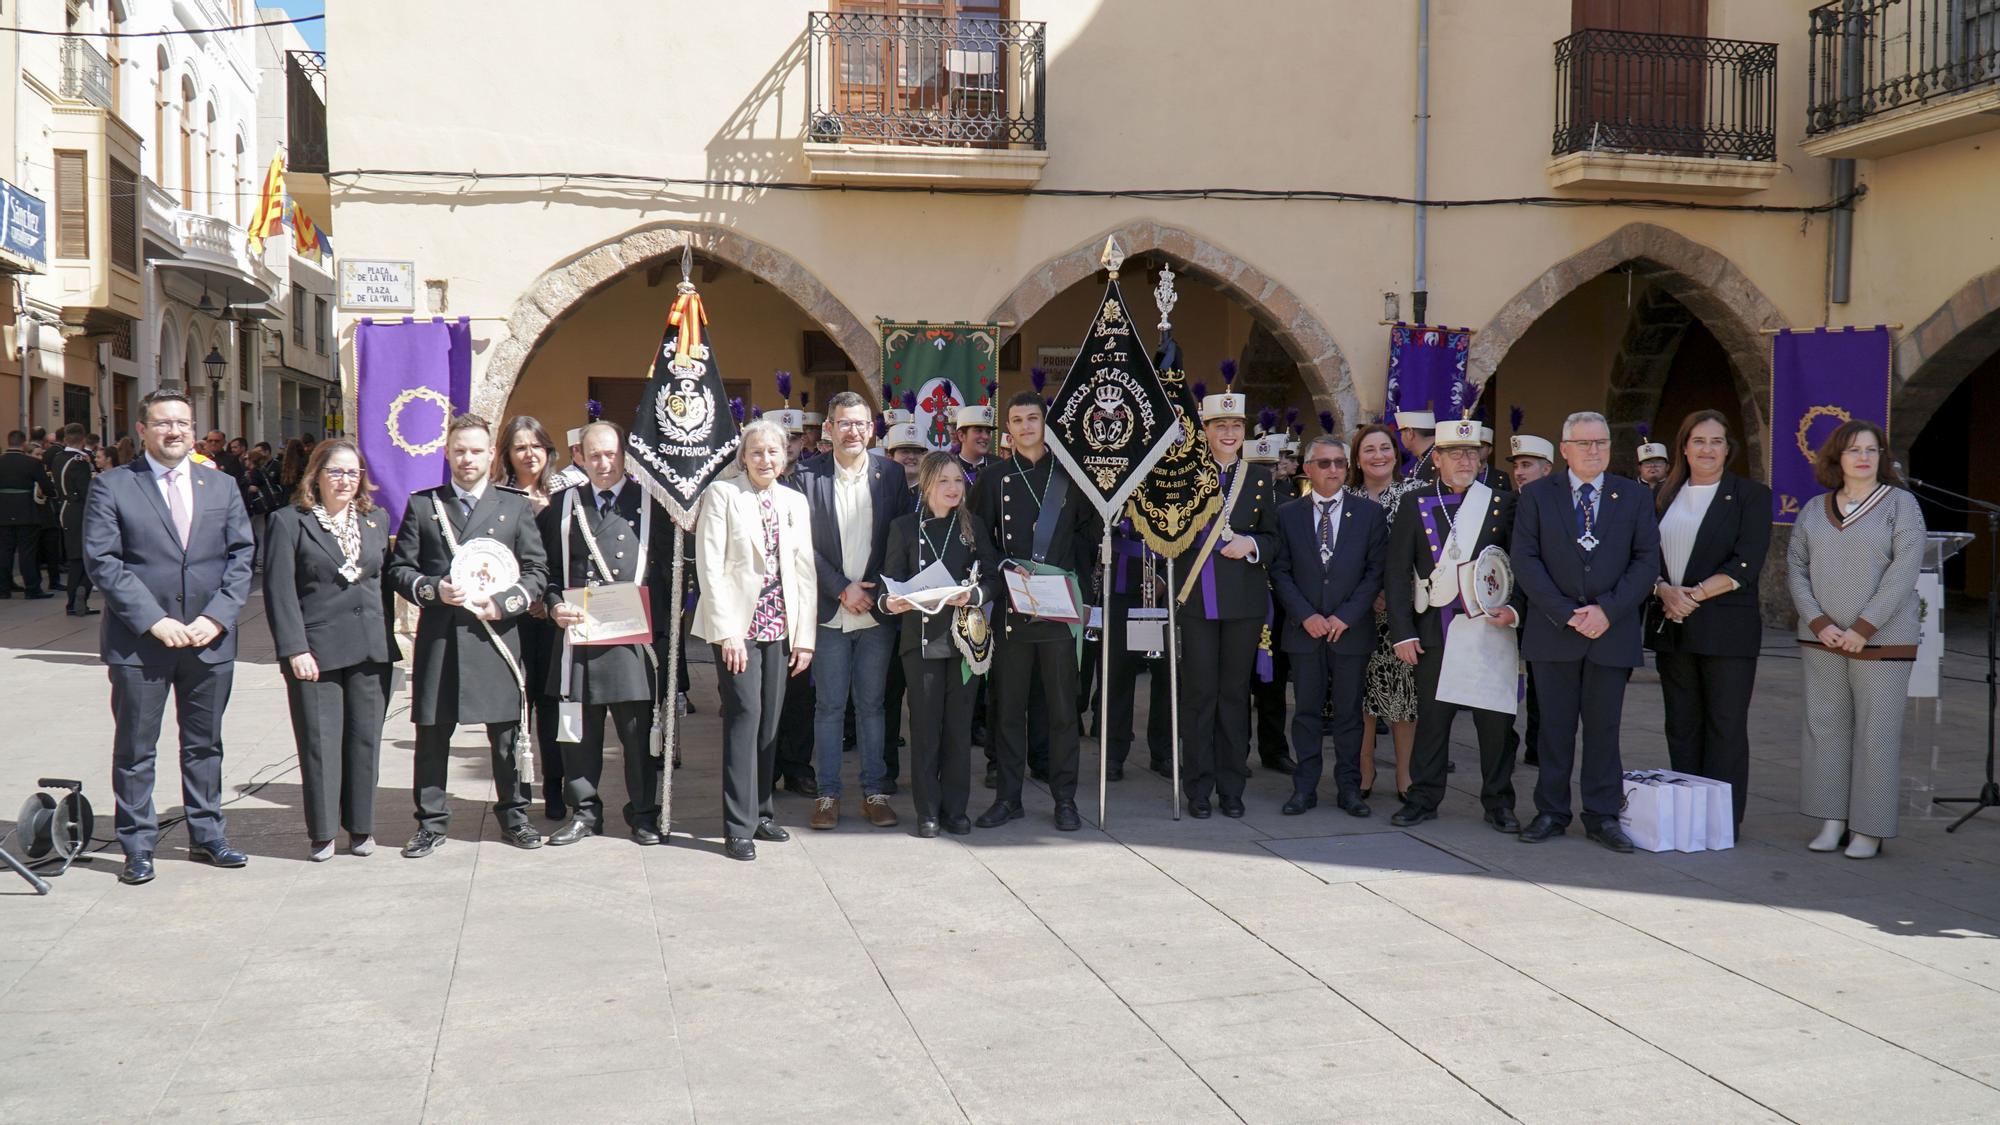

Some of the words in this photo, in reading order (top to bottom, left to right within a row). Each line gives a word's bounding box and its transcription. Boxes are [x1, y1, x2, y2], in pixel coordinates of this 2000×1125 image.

[369, 274, 380, 282] LA
[381, 274, 399, 282] VILA
[366, 286, 391, 294] PLAZA
[381, 295, 399, 303] VILA
[1094, 319, 1130, 337] Banda
[1104, 336, 1117, 350] de
[1095, 367, 1156, 430] MAGDALENA
[658, 443, 711, 457] SENTENCIA
[1083, 455, 1129, 466] ALBACETE
[1169, 469, 1177, 477] de
[1177, 460, 1198, 476] GRACIA
[1155, 479, 1188, 488] VILA-REAL
[1165, 492, 1180, 500] 2010
